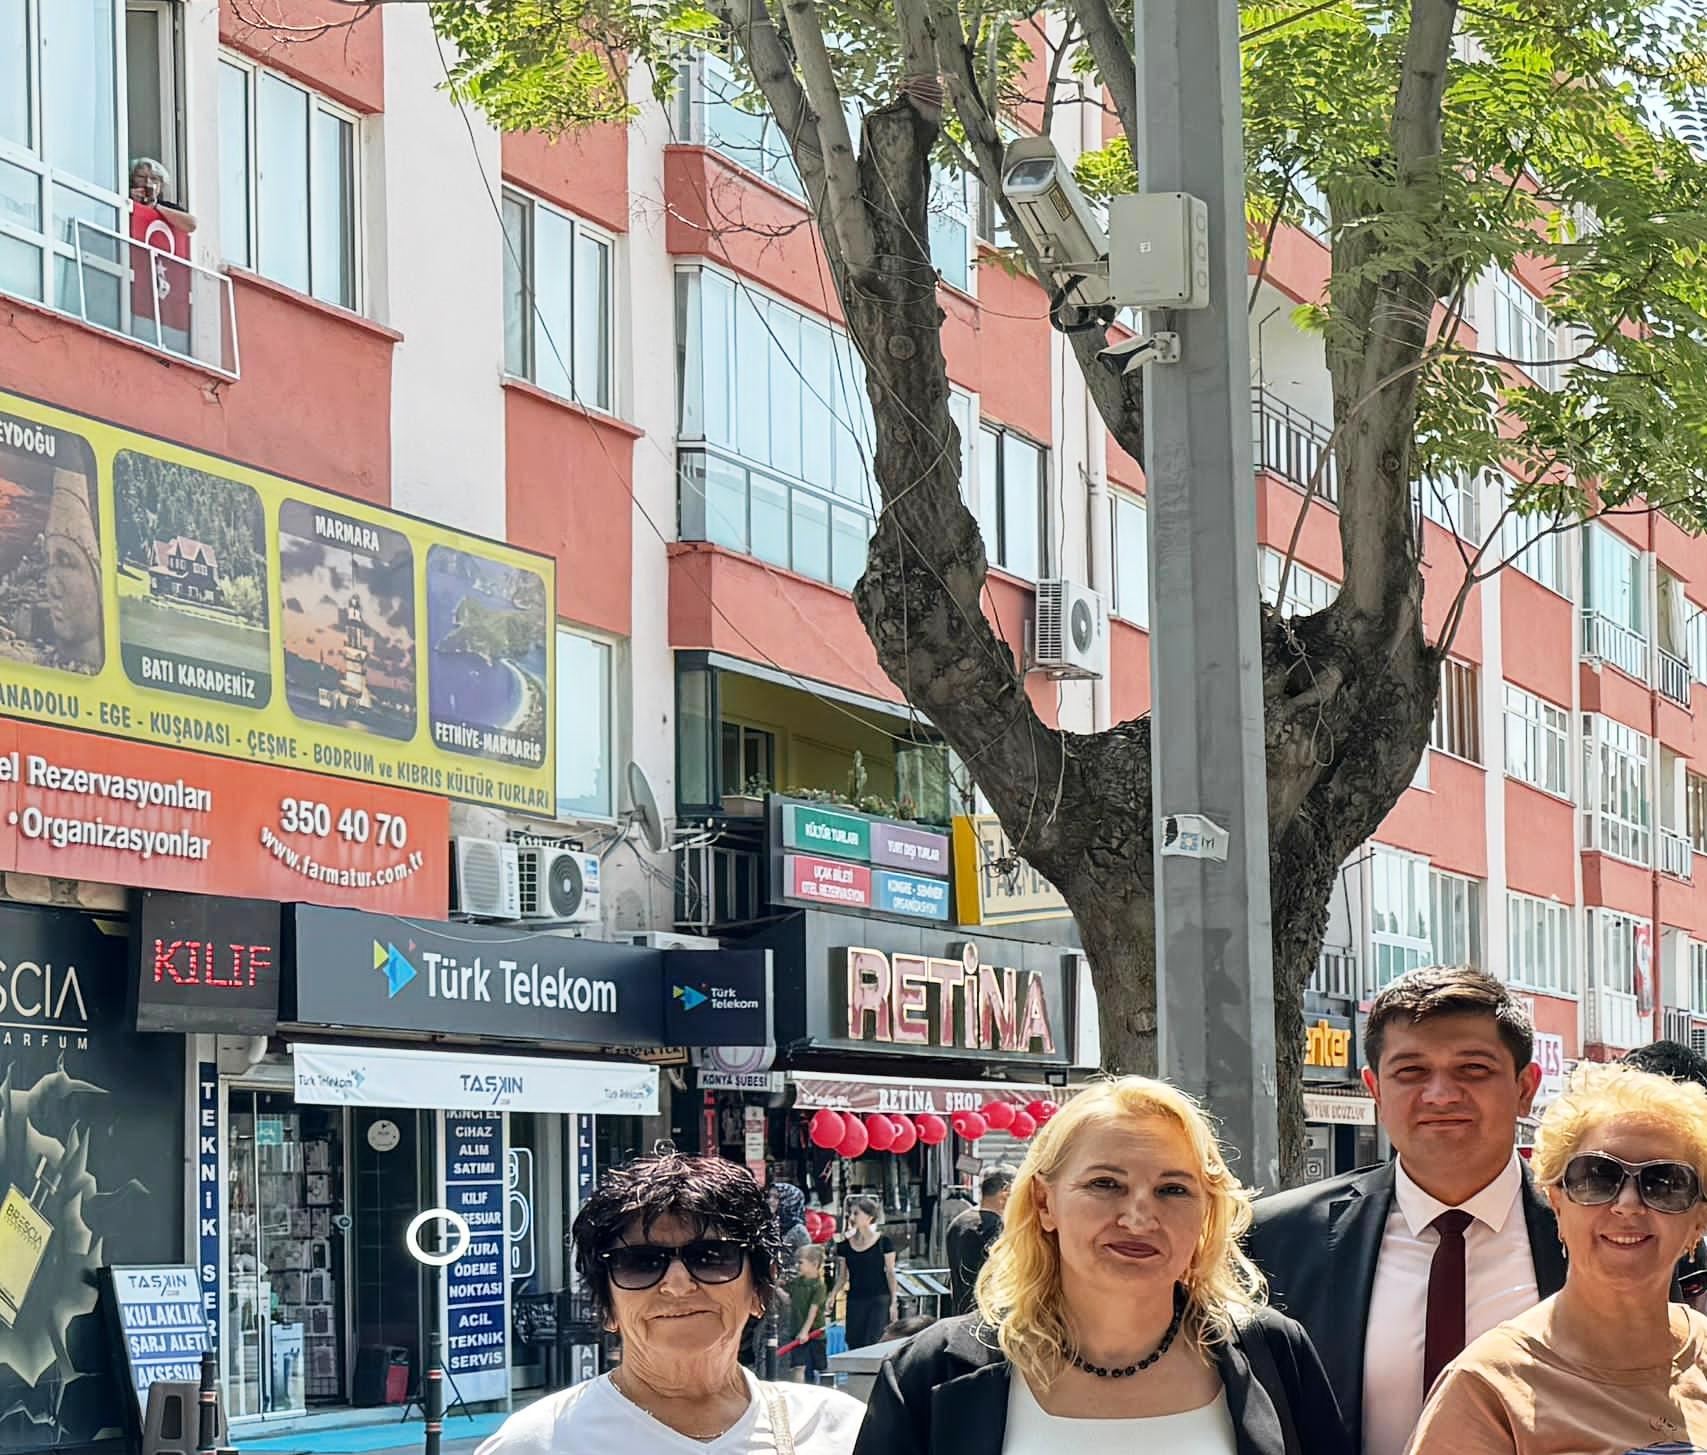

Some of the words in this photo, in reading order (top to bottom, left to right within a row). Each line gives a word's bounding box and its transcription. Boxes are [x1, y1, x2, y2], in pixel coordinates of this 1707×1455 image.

[315, 514, 380, 552] MARMARA
[141, 655, 173, 686] BATI
[178, 664, 256, 699] KARADENİZ
[434, 721, 542, 762] FETHİYE-MARMARİS
[100, 702, 131, 729] EGE
[150, 712, 230, 746] KUŞADASI
[247, 730, 297, 761] ÇEŞME
[313, 743, 374, 775] BODRUM
[379, 764, 393, 779] ve
[397, 761, 442, 790] KIBRIS
[447, 768, 494, 799] KÜLTÜR
[497, 781, 549, 809] TURLARI
[26, 754, 212, 813] Rezervasyonları
[22, 806, 212, 860] Organizasyonlar
[279, 797, 331, 838] 350
[337, 806, 369, 844] 40
[375, 811, 408, 849] 70
[260, 826, 425, 889] www.farmatur.com.tr
[153, 938, 272, 987] KILIF
[422, 951, 491, 1002] Türk
[499, 959, 617, 1014] Telekom
[711, 987, 736, 998] Türk
[711, 998, 759, 1009] Telekom
[945, 1091, 983, 1112] SHOP
[455, 1124, 493, 1138] CİHAZ
[201, 1081, 216, 1237] TEKNİK
[459, 1143, 490, 1156] ALIM
[453, 1162, 495, 1175] SATIMI
[461, 1191, 489, 1205] KILIF
[454, 1262, 497, 1278] ÖDEME
[123, 1303, 203, 1327] KULAKLIK
[458, 1312, 492, 1328] ACİL
[130, 1334, 166, 1358] ŞARJ
[449, 1332, 504, 1349] TEKNİK
[450, 1352, 503, 1369] SERVİS
